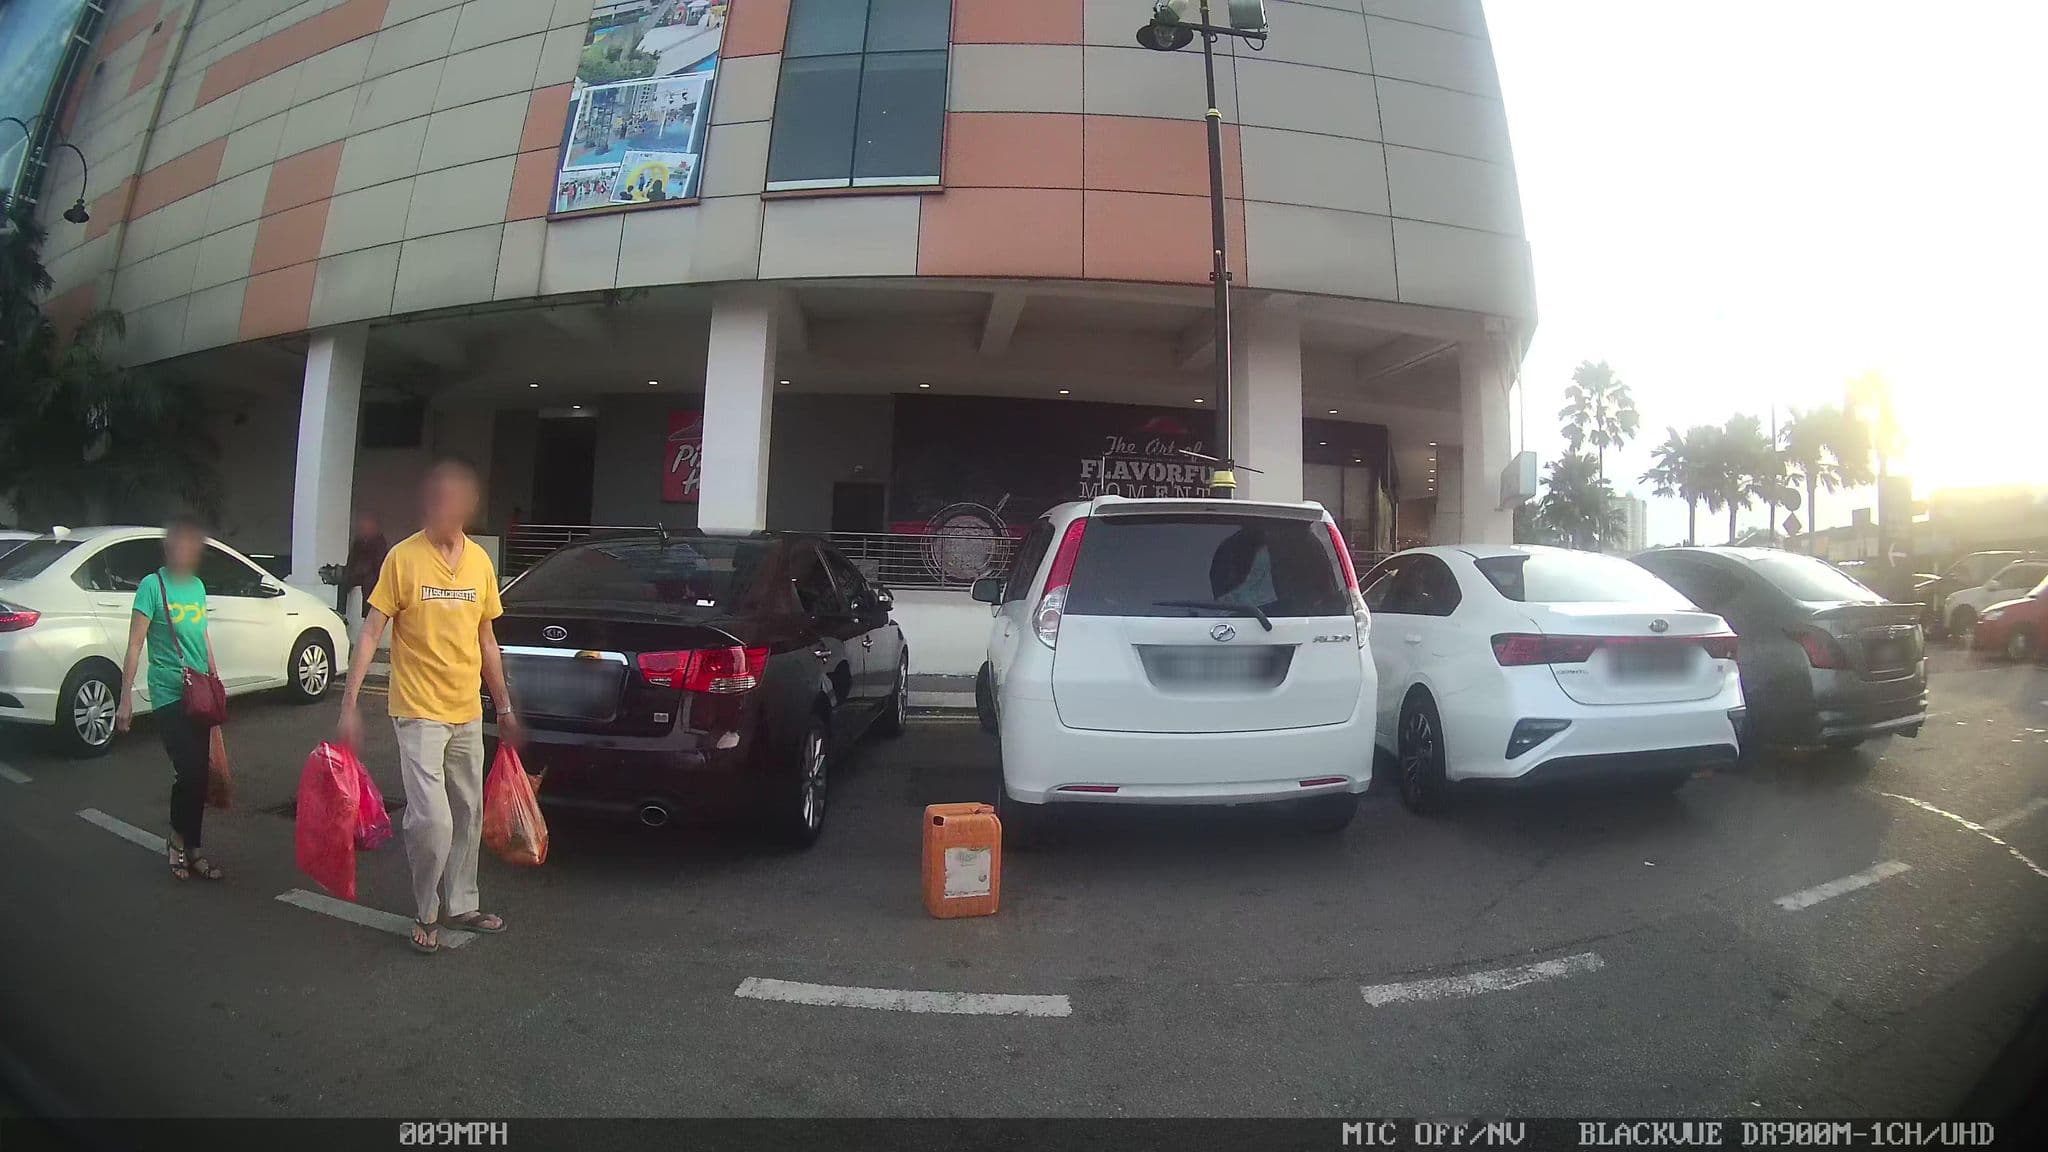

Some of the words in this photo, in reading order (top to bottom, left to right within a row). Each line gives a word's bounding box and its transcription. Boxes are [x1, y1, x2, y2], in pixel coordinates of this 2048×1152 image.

[671, 444, 702, 473] Pi
[1104, 435, 1137, 456] The
[1144, 437, 1175, 456] Art
[1183, 441, 1203, 463] of
[1080, 459, 1215, 485] FLAVORFU
